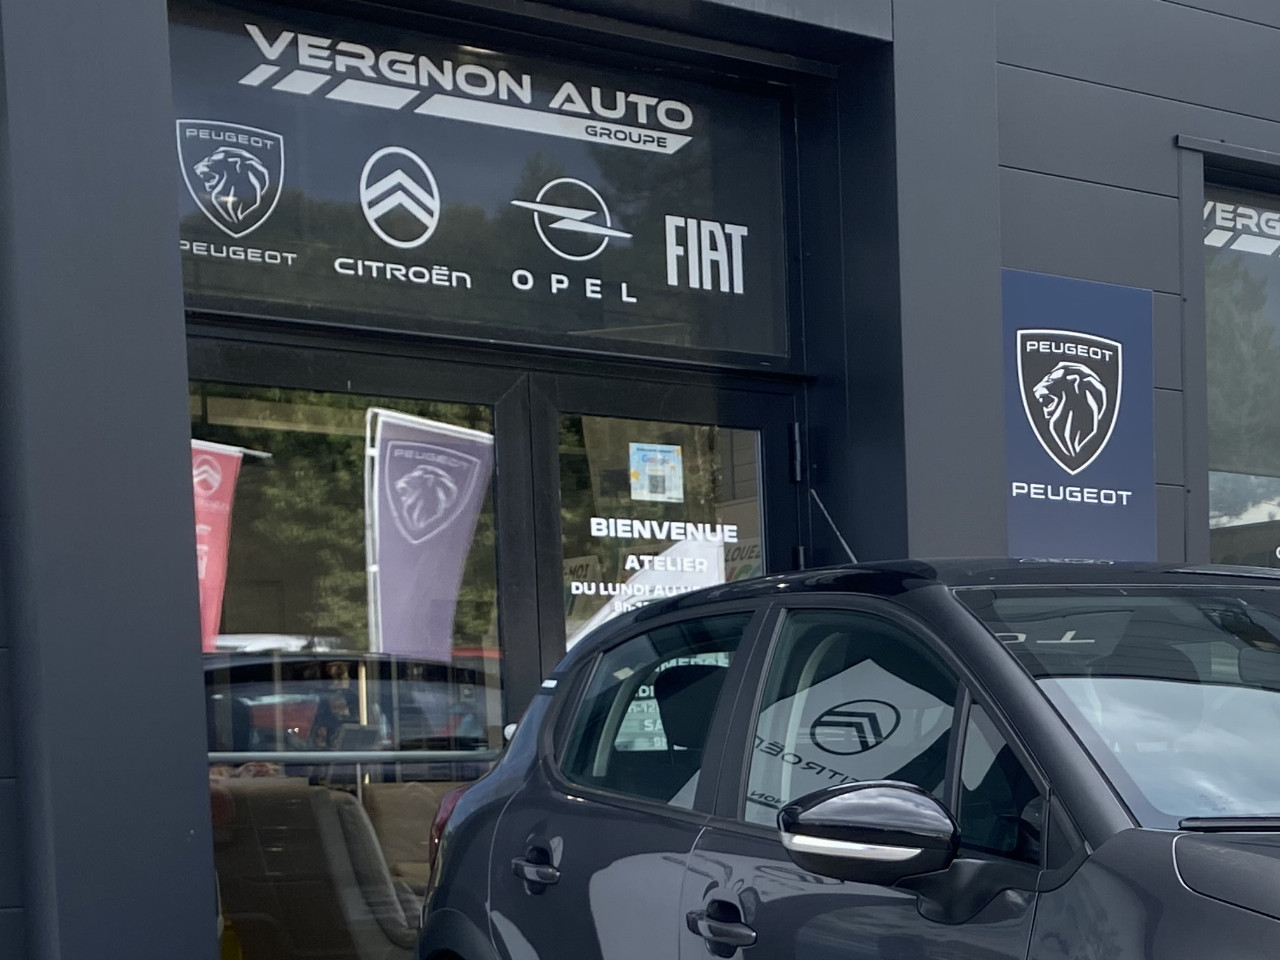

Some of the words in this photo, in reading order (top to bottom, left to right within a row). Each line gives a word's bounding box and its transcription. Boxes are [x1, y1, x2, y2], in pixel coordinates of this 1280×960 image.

[244, 23, 531, 104] VERGNON
[548, 81, 694, 130] AUTO
[185, 127, 275, 151] PEUGEOT
[584, 124, 668, 149] GROUPE
[180, 239, 298, 266] PEUGEOT
[664, 214, 749, 295] FIAT
[511, 269, 638, 303] OPEL
[1025, 340, 1114, 363] PEUGEOT
[393, 448, 471, 470] PEUGEOT
[1011, 481, 1132, 505] PEUGEOT
[590, 517, 738, 543] BIENVENUE
[625, 554, 708, 573] ATELIER
[570, 581, 597, 595] DU
[599, 582, 651, 597] LUNDI
